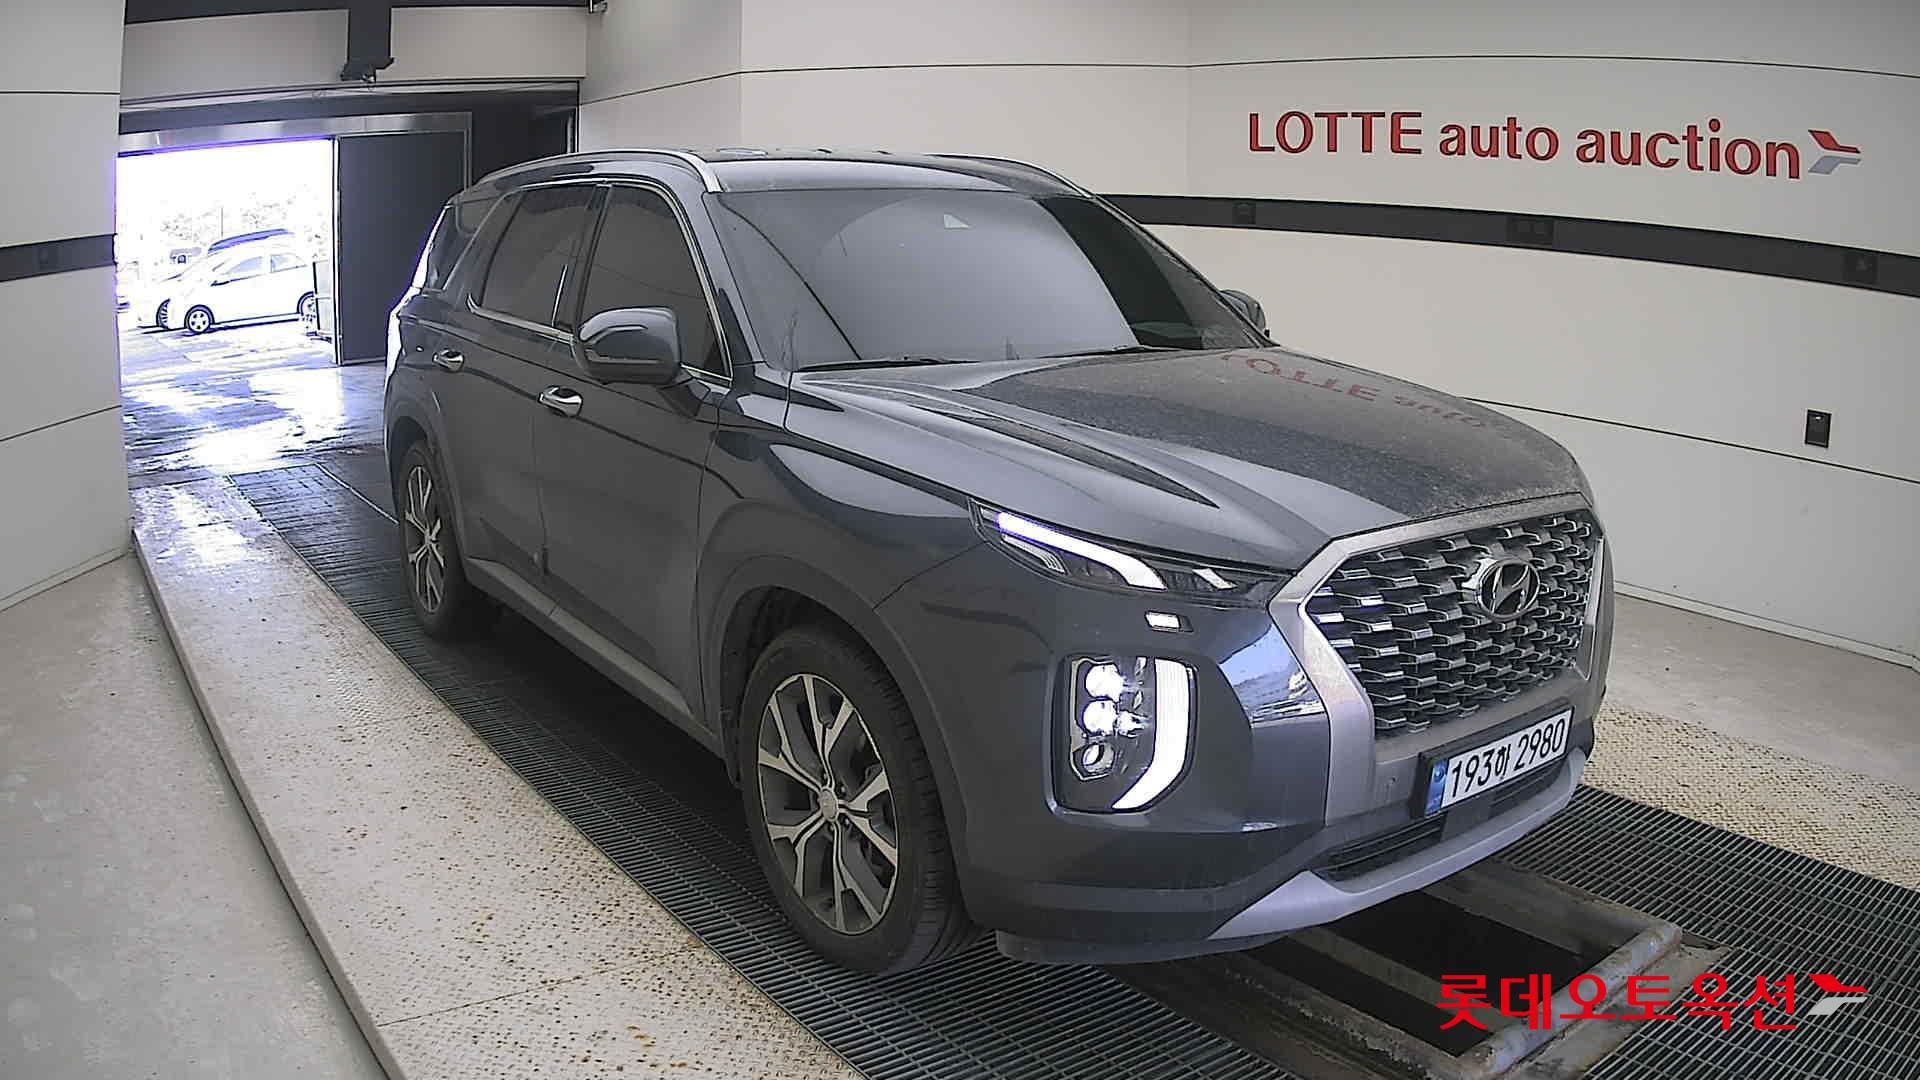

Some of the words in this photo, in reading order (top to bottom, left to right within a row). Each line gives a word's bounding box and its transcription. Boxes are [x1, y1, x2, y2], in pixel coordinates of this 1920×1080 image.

[1248, 111, 1423, 155] LOTTE
[1438, 116, 1560, 162] auto
[1575, 118, 1801, 180] auction
[1514, 718, 1566, 772] 2980
